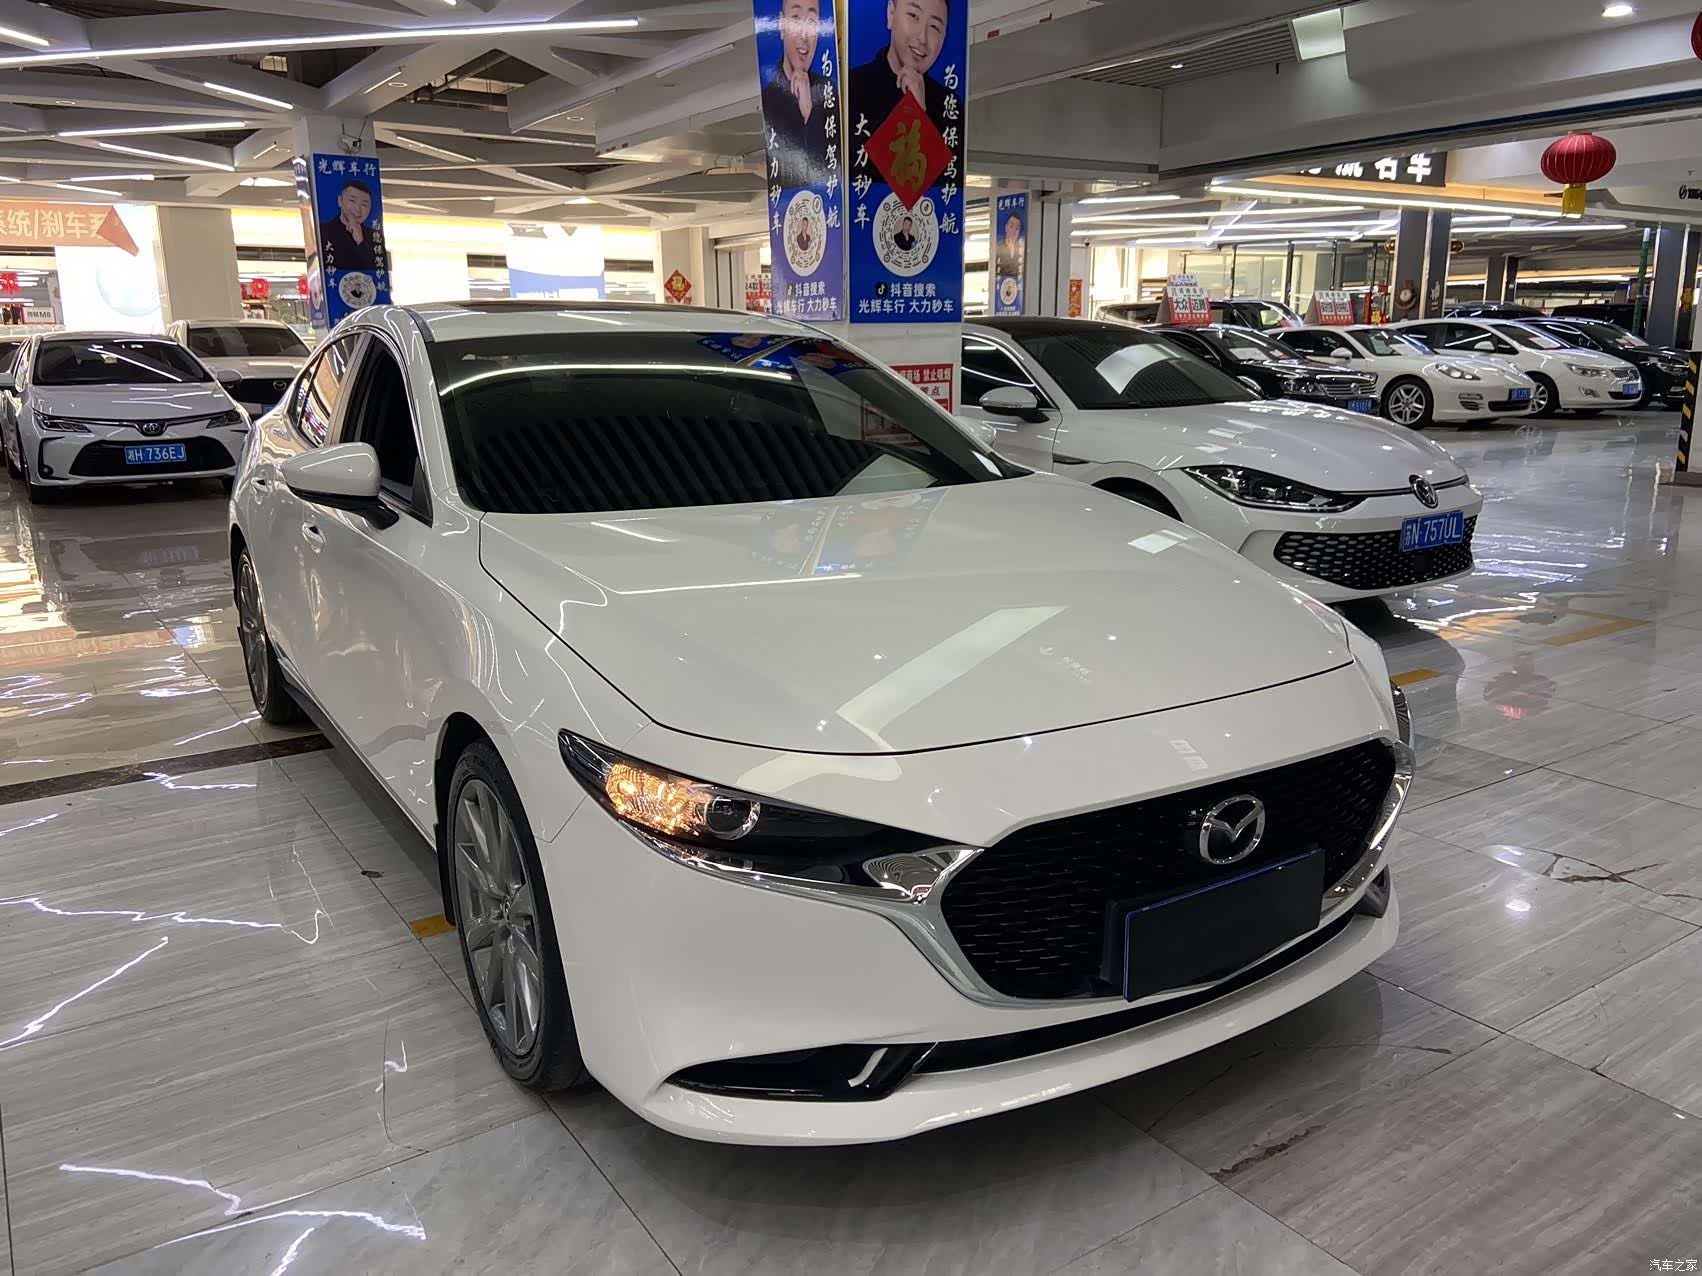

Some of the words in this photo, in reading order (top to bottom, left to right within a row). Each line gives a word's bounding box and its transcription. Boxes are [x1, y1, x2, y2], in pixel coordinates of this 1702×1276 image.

[889, 119, 928, 193] 福
[851, 112, 873, 231] 大力秒车
[795, 281, 826, 298] 抖音搜索
[890, 282, 936, 298] 抖音搜索
[859, 299, 905, 314] 光辉车行
[908, 298, 954, 314] 大力秒车
